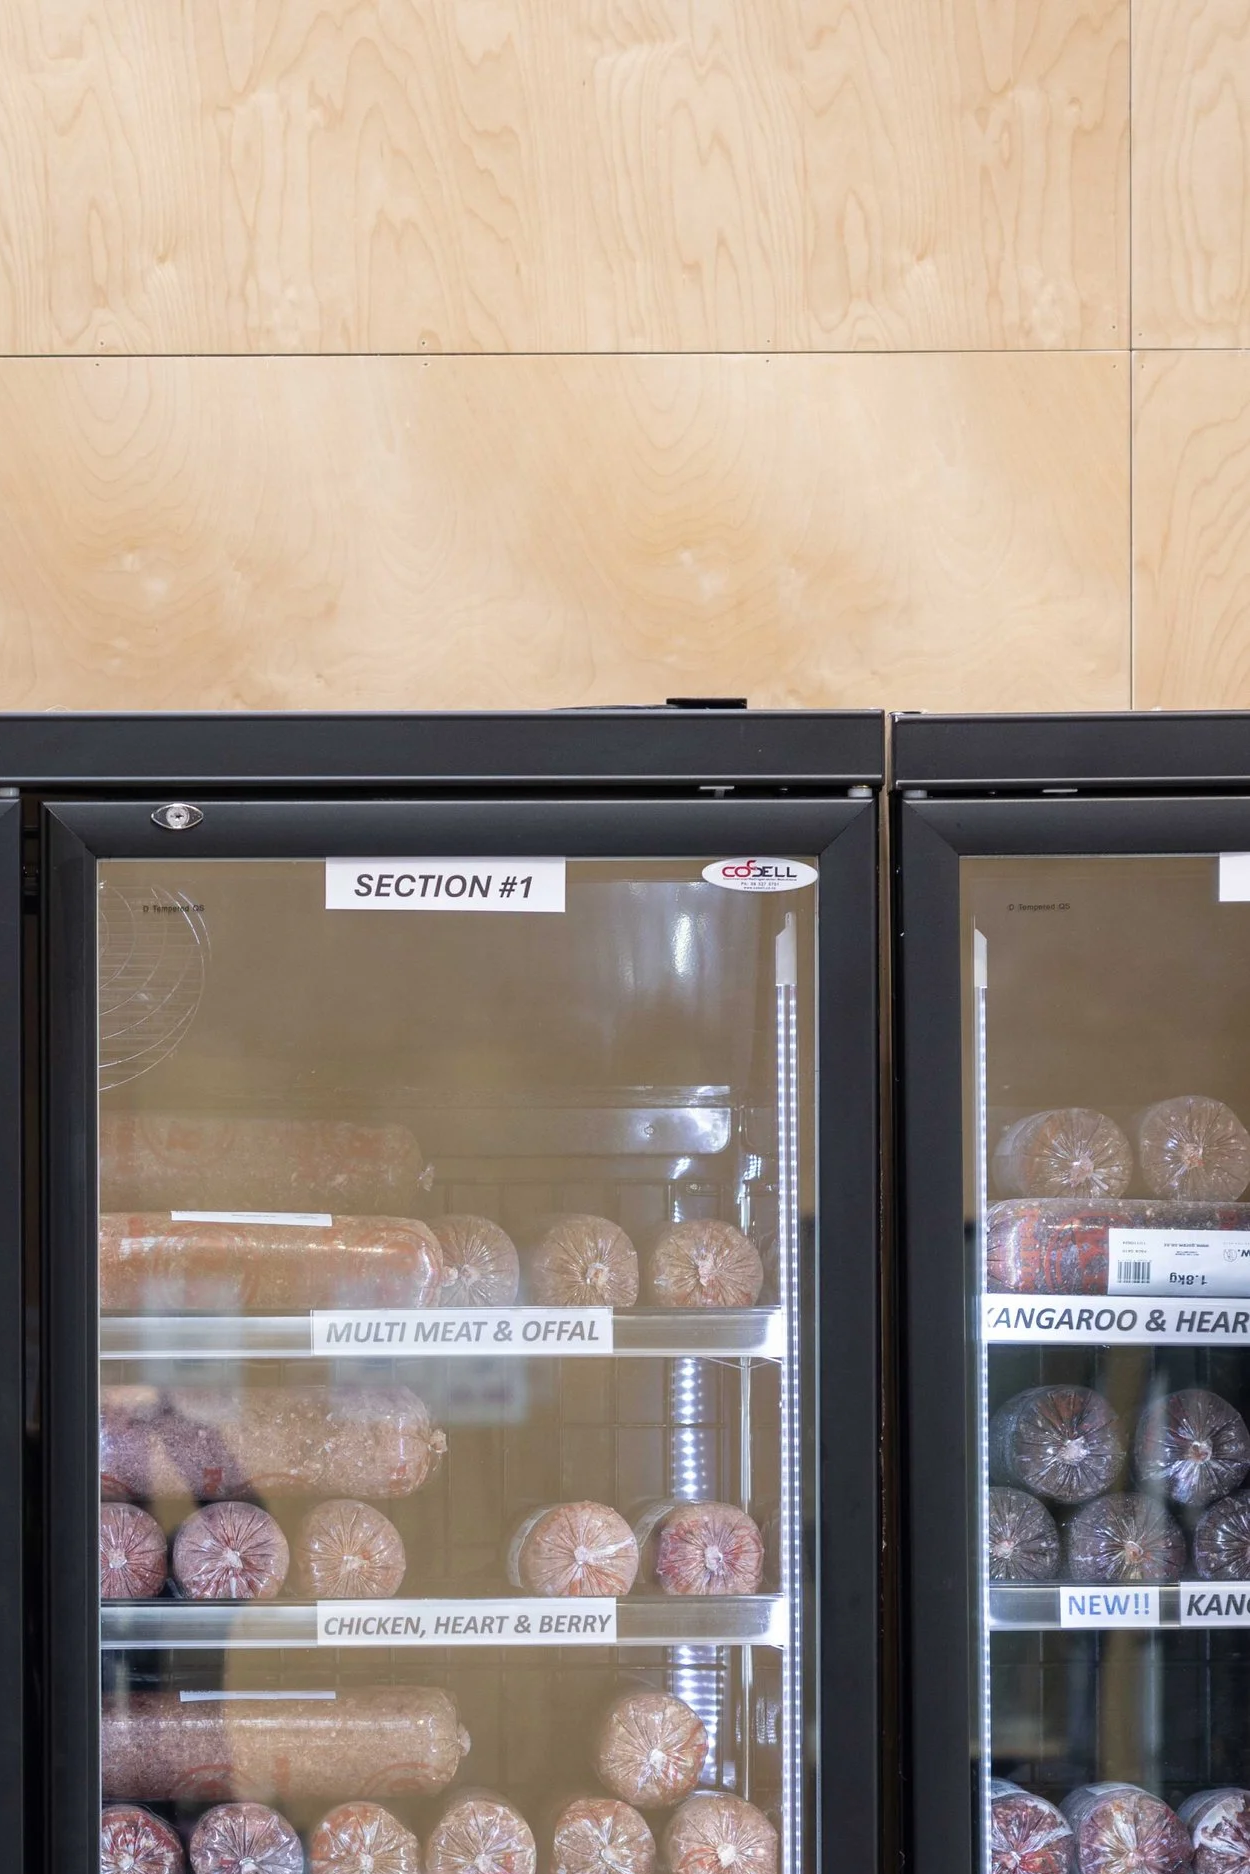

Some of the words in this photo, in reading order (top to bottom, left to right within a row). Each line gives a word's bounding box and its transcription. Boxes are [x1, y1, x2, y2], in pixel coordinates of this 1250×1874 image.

[354, 874, 493, 899] SECTION
[498, 875, 534, 899] #1
[1170, 1272, 1208, 1285] 1.8kg
[326, 1321, 406, 1344] MULTI
[413, 1321, 488, 1343] MEAT
[494, 1320, 514, 1342] &
[521, 1319, 600, 1342] OFFAL
[987, 1308, 1137, 1331] ANGAROO
[1145, 1309, 1166, 1332] &
[1069, 1594, 1150, 1616] NEW!!
[324, 1616, 426, 1638] CHICKEN,
[434, 1615, 508, 1635] HEART
[514, 1614, 532, 1634] &
[538, 1613, 611, 1634] BERRY
